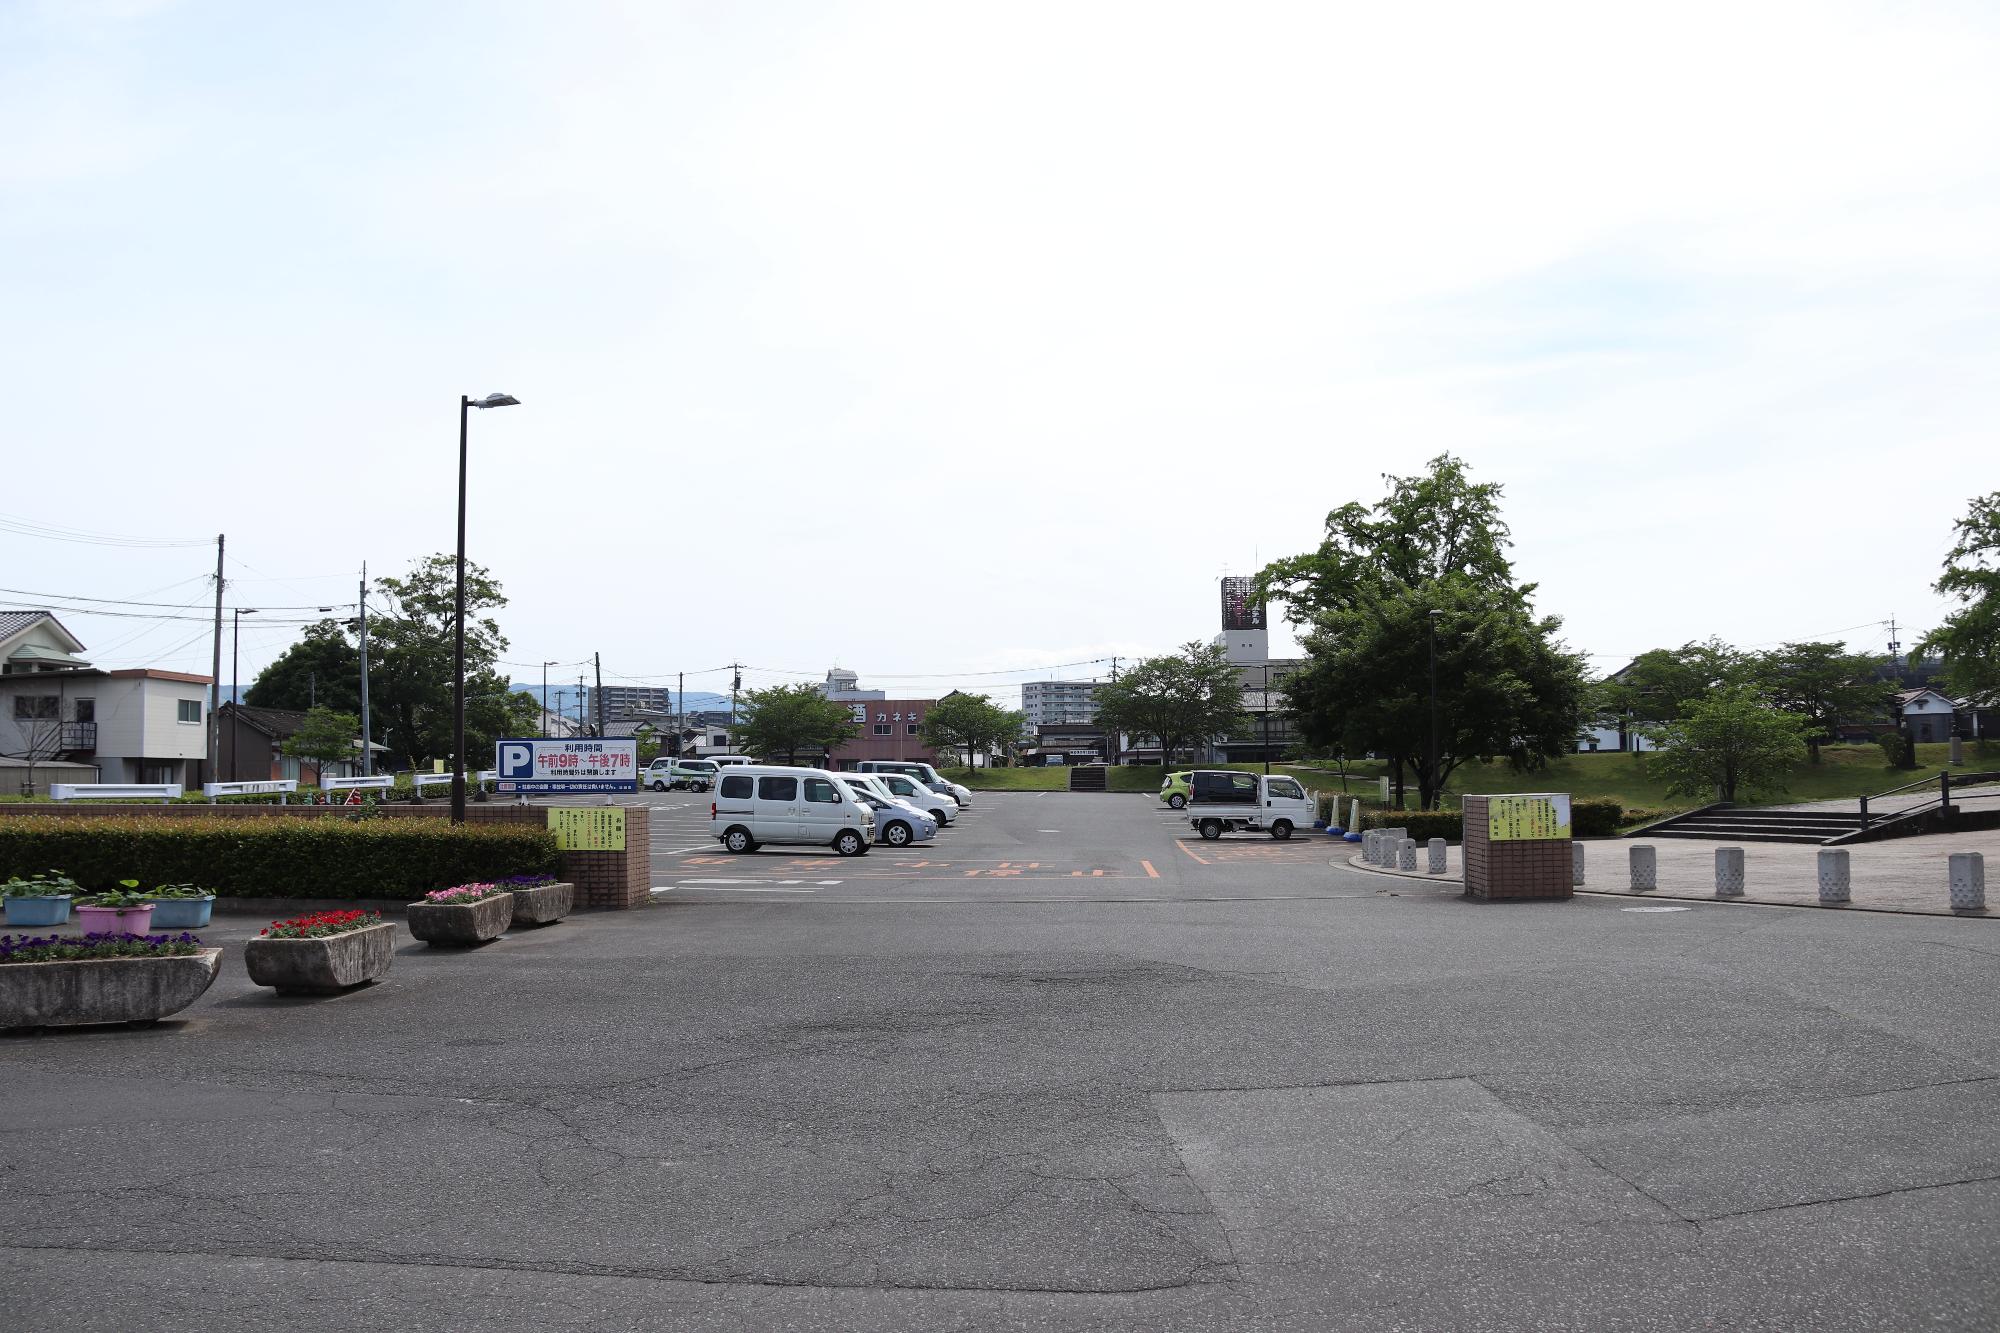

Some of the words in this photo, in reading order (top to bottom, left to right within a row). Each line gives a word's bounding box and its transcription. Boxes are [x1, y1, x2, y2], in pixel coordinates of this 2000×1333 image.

[564, 744, 603, 753] 利用時間
[503, 745, 531, 776] P
